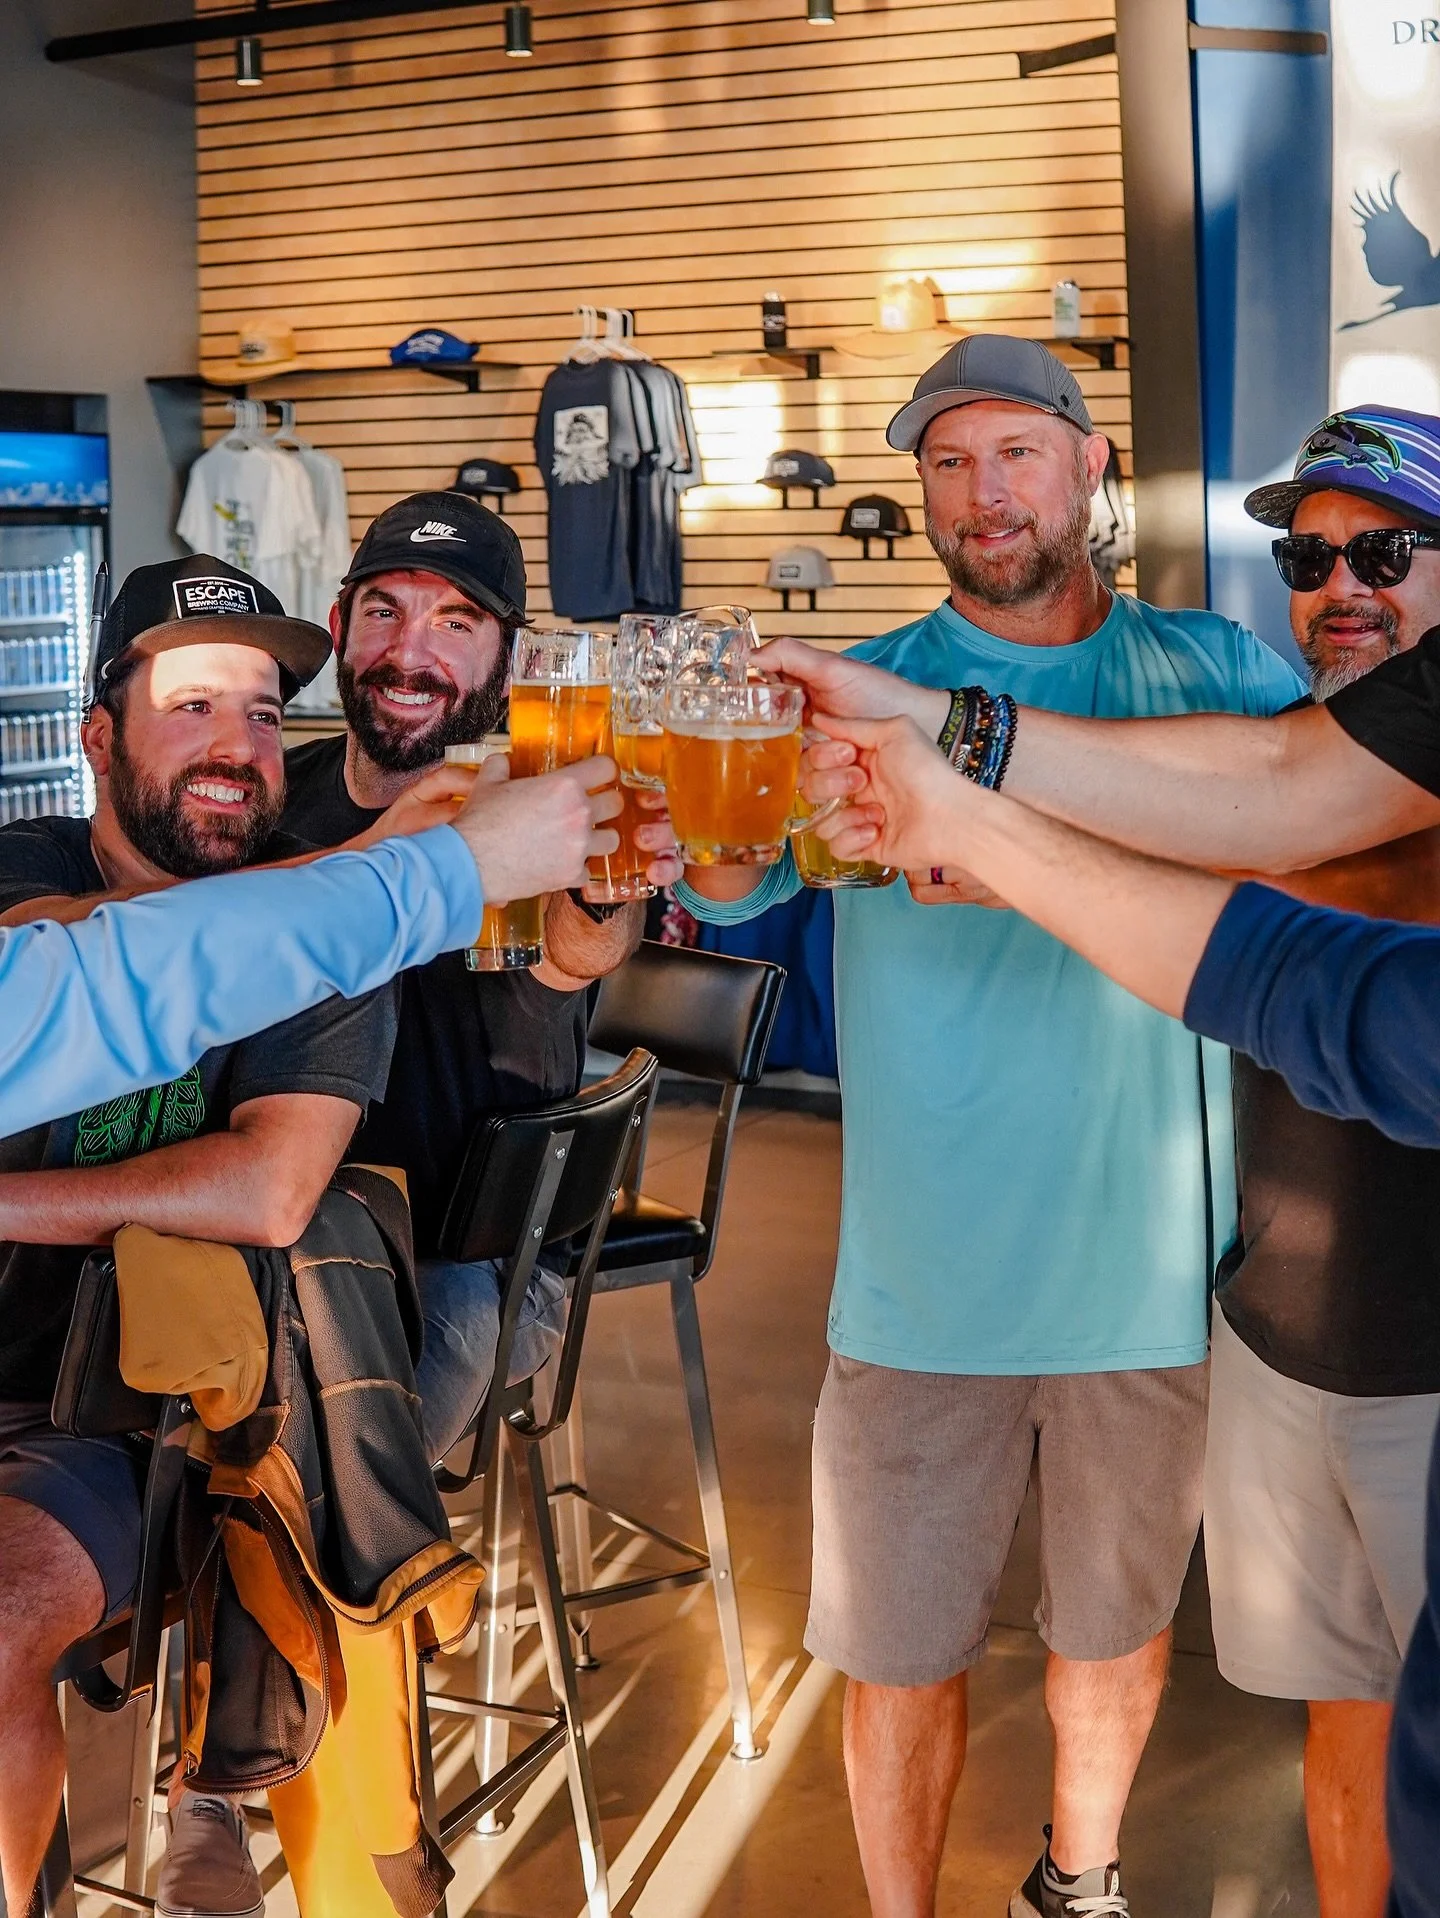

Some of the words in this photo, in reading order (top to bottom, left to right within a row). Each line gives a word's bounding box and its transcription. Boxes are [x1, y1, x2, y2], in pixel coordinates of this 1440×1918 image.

[1392, 18, 1440, 44] DR
[420, 520, 458, 536] NIKE
[185, 585, 248, 605] ESCAPE
[187, 599, 219, 608] BREWING
[219, 599, 250, 612] COMPANY
